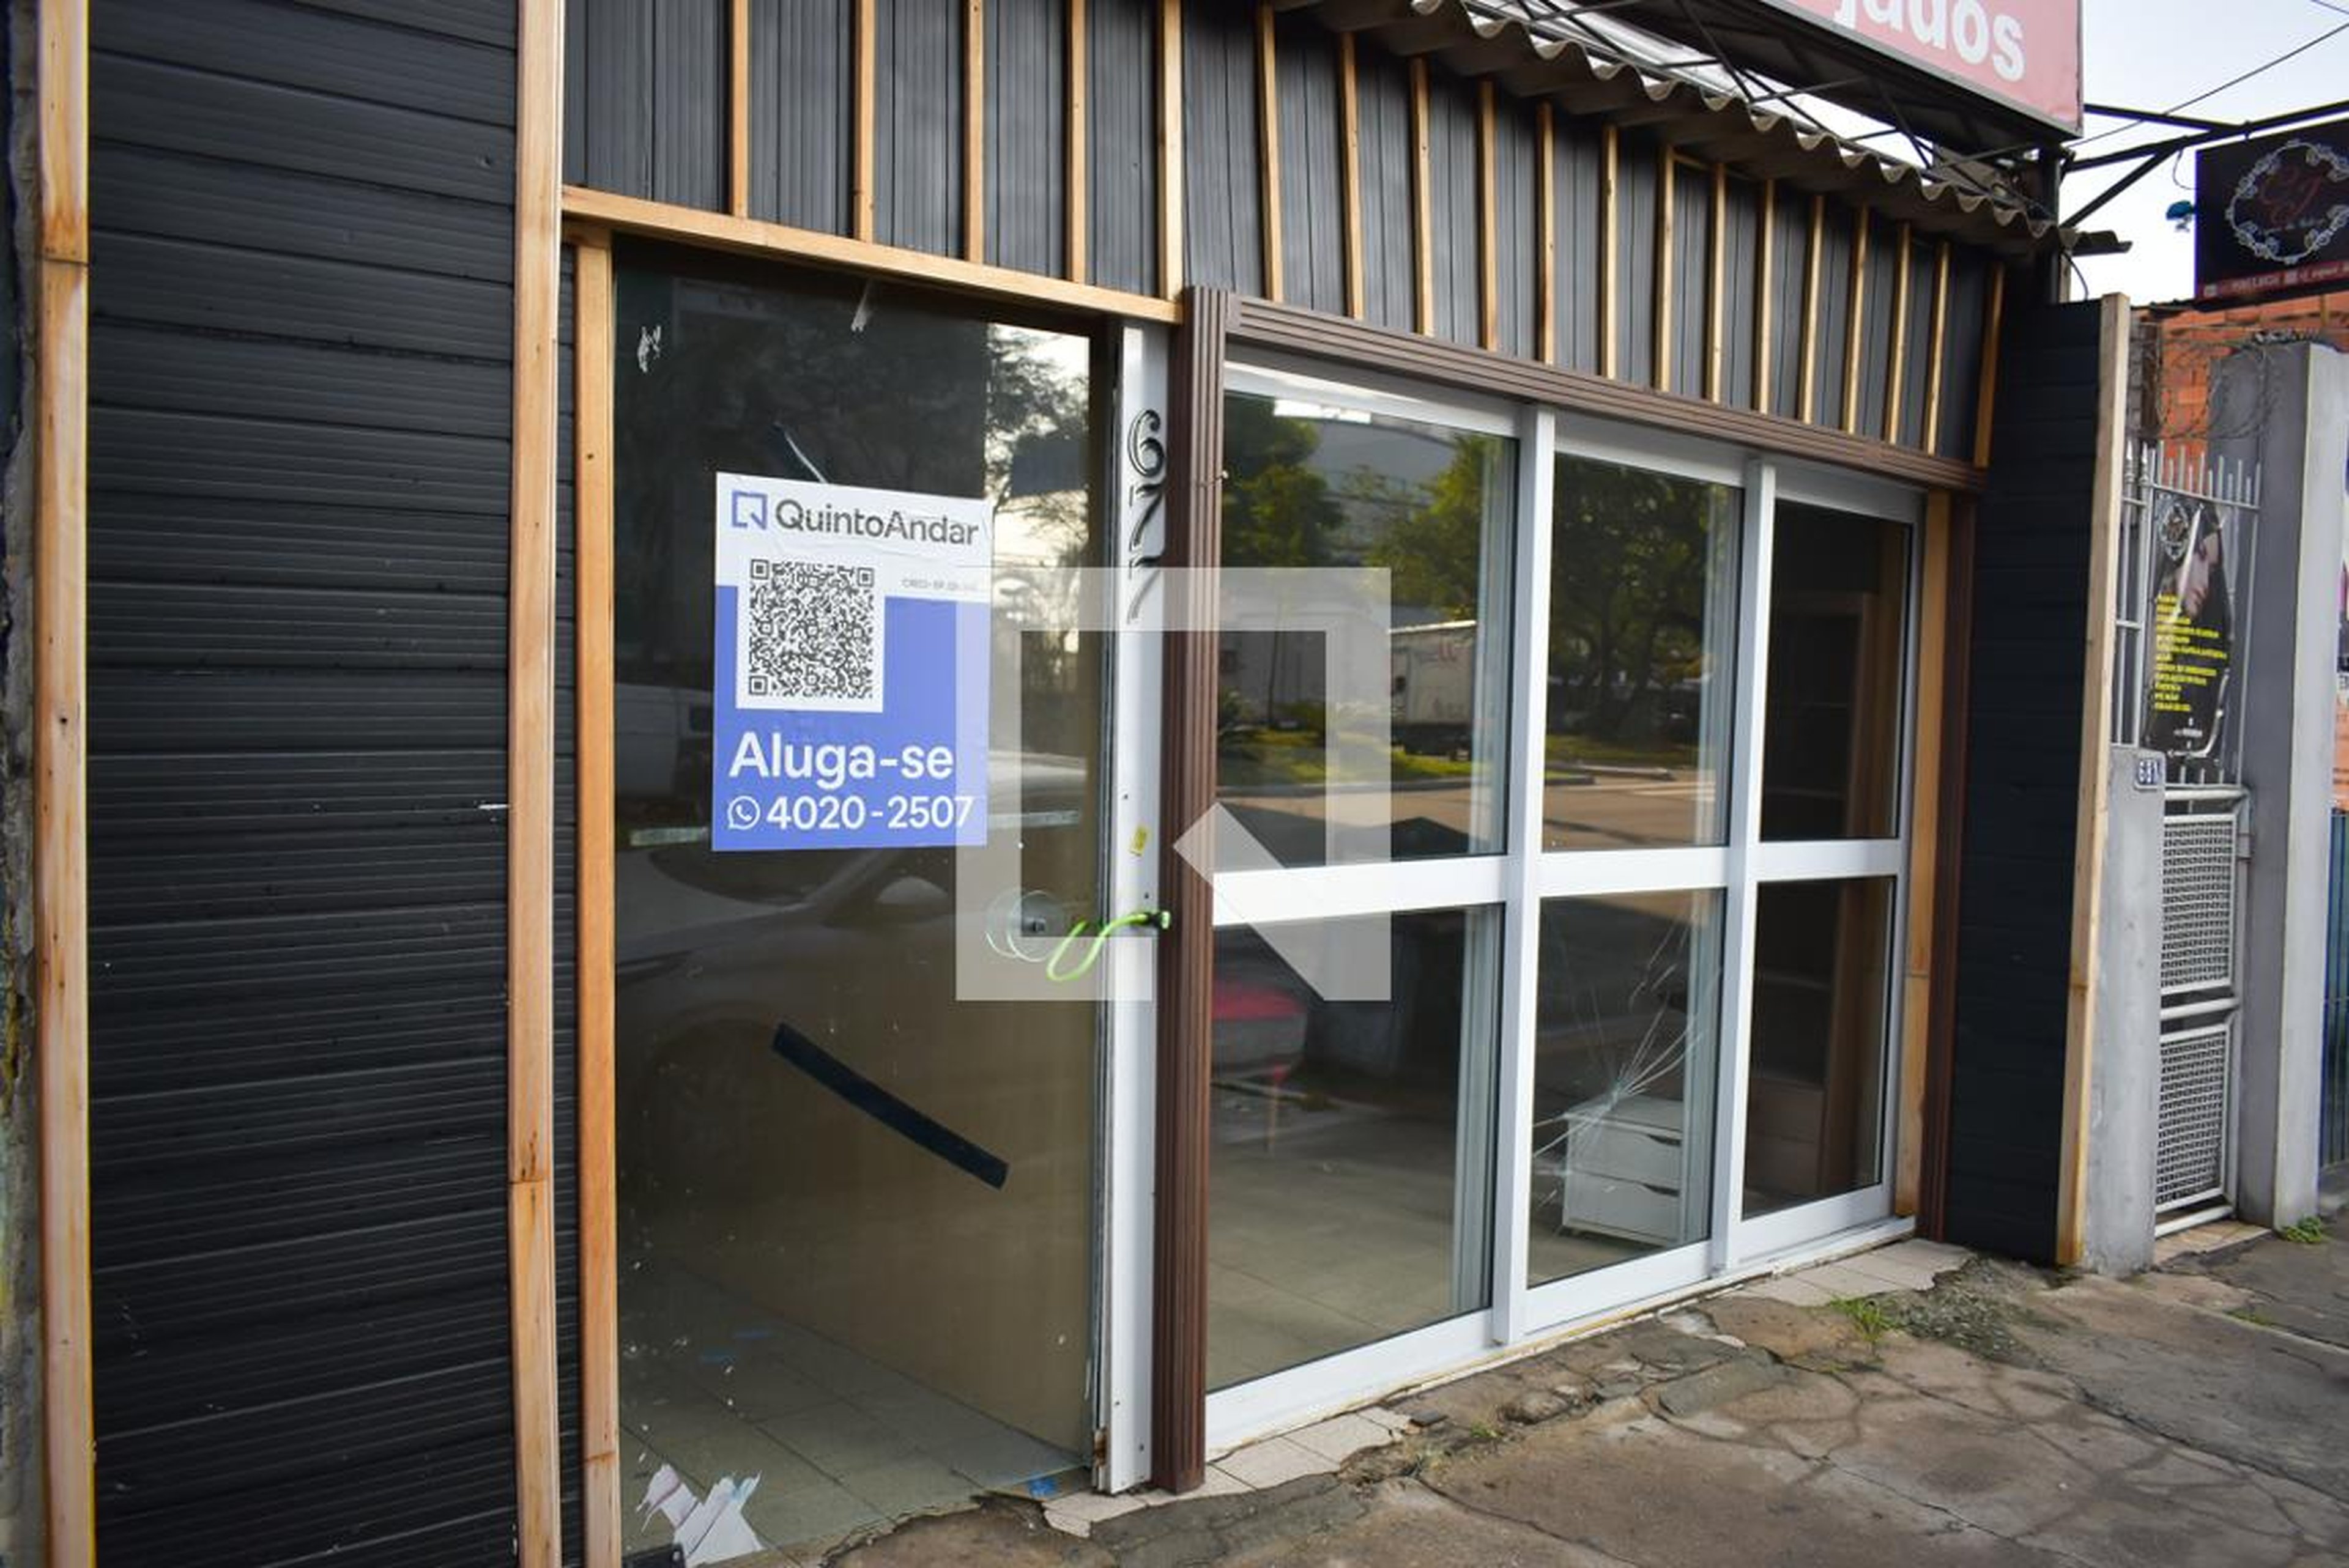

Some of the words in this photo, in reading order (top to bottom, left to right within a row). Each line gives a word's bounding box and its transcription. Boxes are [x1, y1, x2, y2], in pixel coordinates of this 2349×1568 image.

[775, 498, 979, 545] QuintoAndar
[1127, 409, 1166, 625] 677
[729, 732, 954, 790] Aluga-se
[766, 796, 974, 830] 4020-2507
